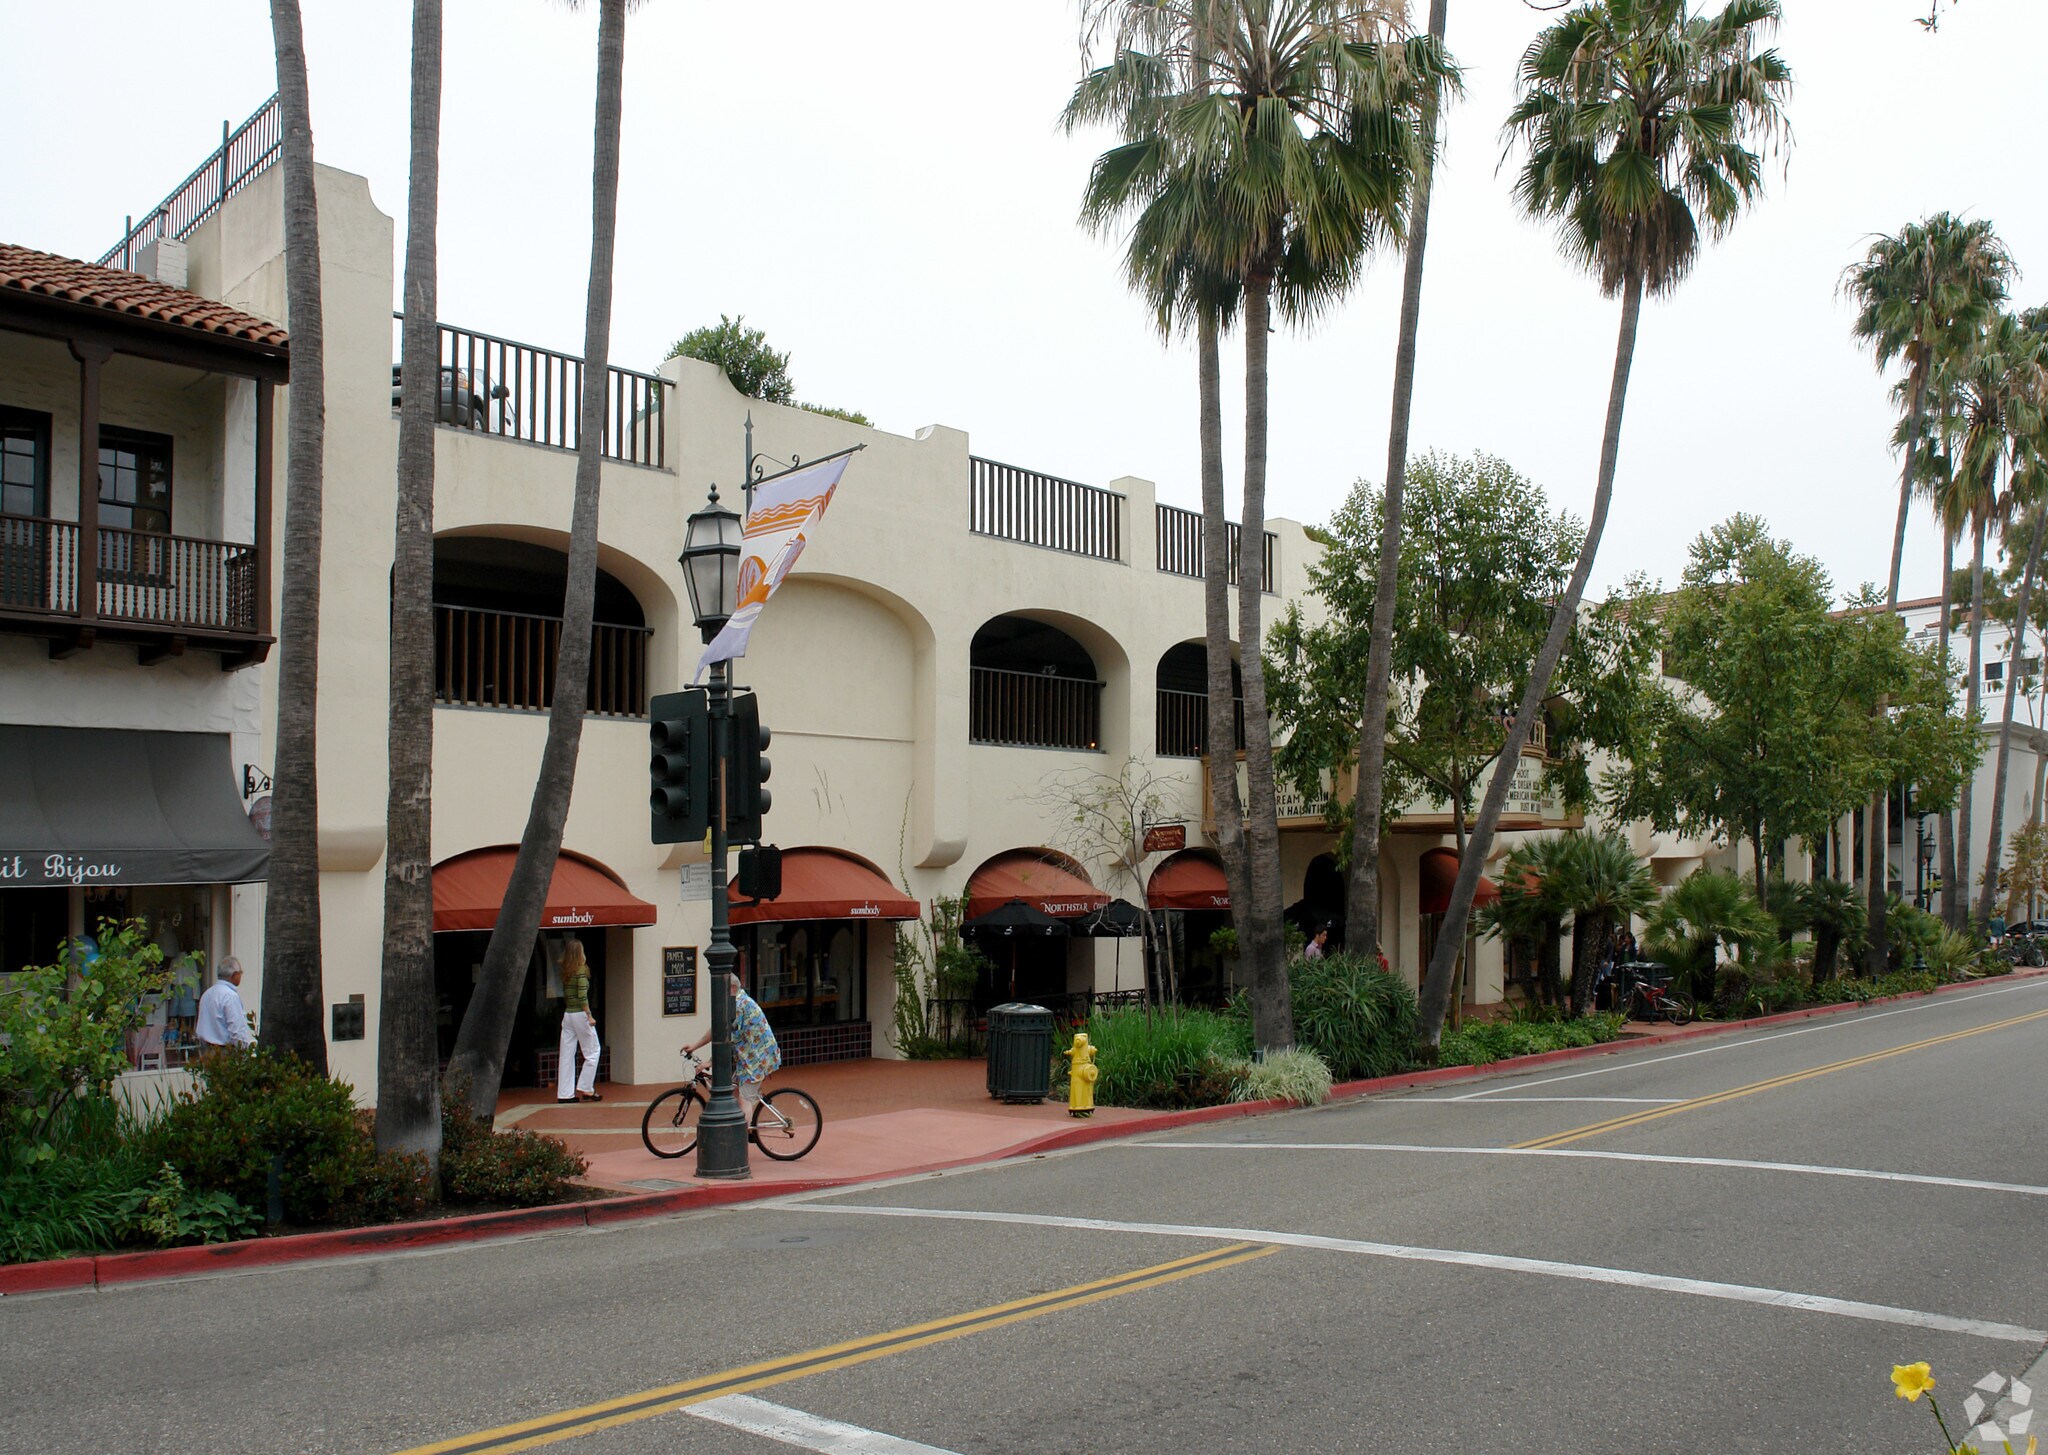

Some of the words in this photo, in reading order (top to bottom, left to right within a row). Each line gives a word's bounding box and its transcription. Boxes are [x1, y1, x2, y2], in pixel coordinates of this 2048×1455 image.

[1276, 794, 1300, 805] REAM
[44, 854, 121, 884] Bijou
[552, 907, 594, 925] sumbody
[851, 900, 881, 917] sumbody
[1040, 902, 1090, 914] NORTHSTAR
